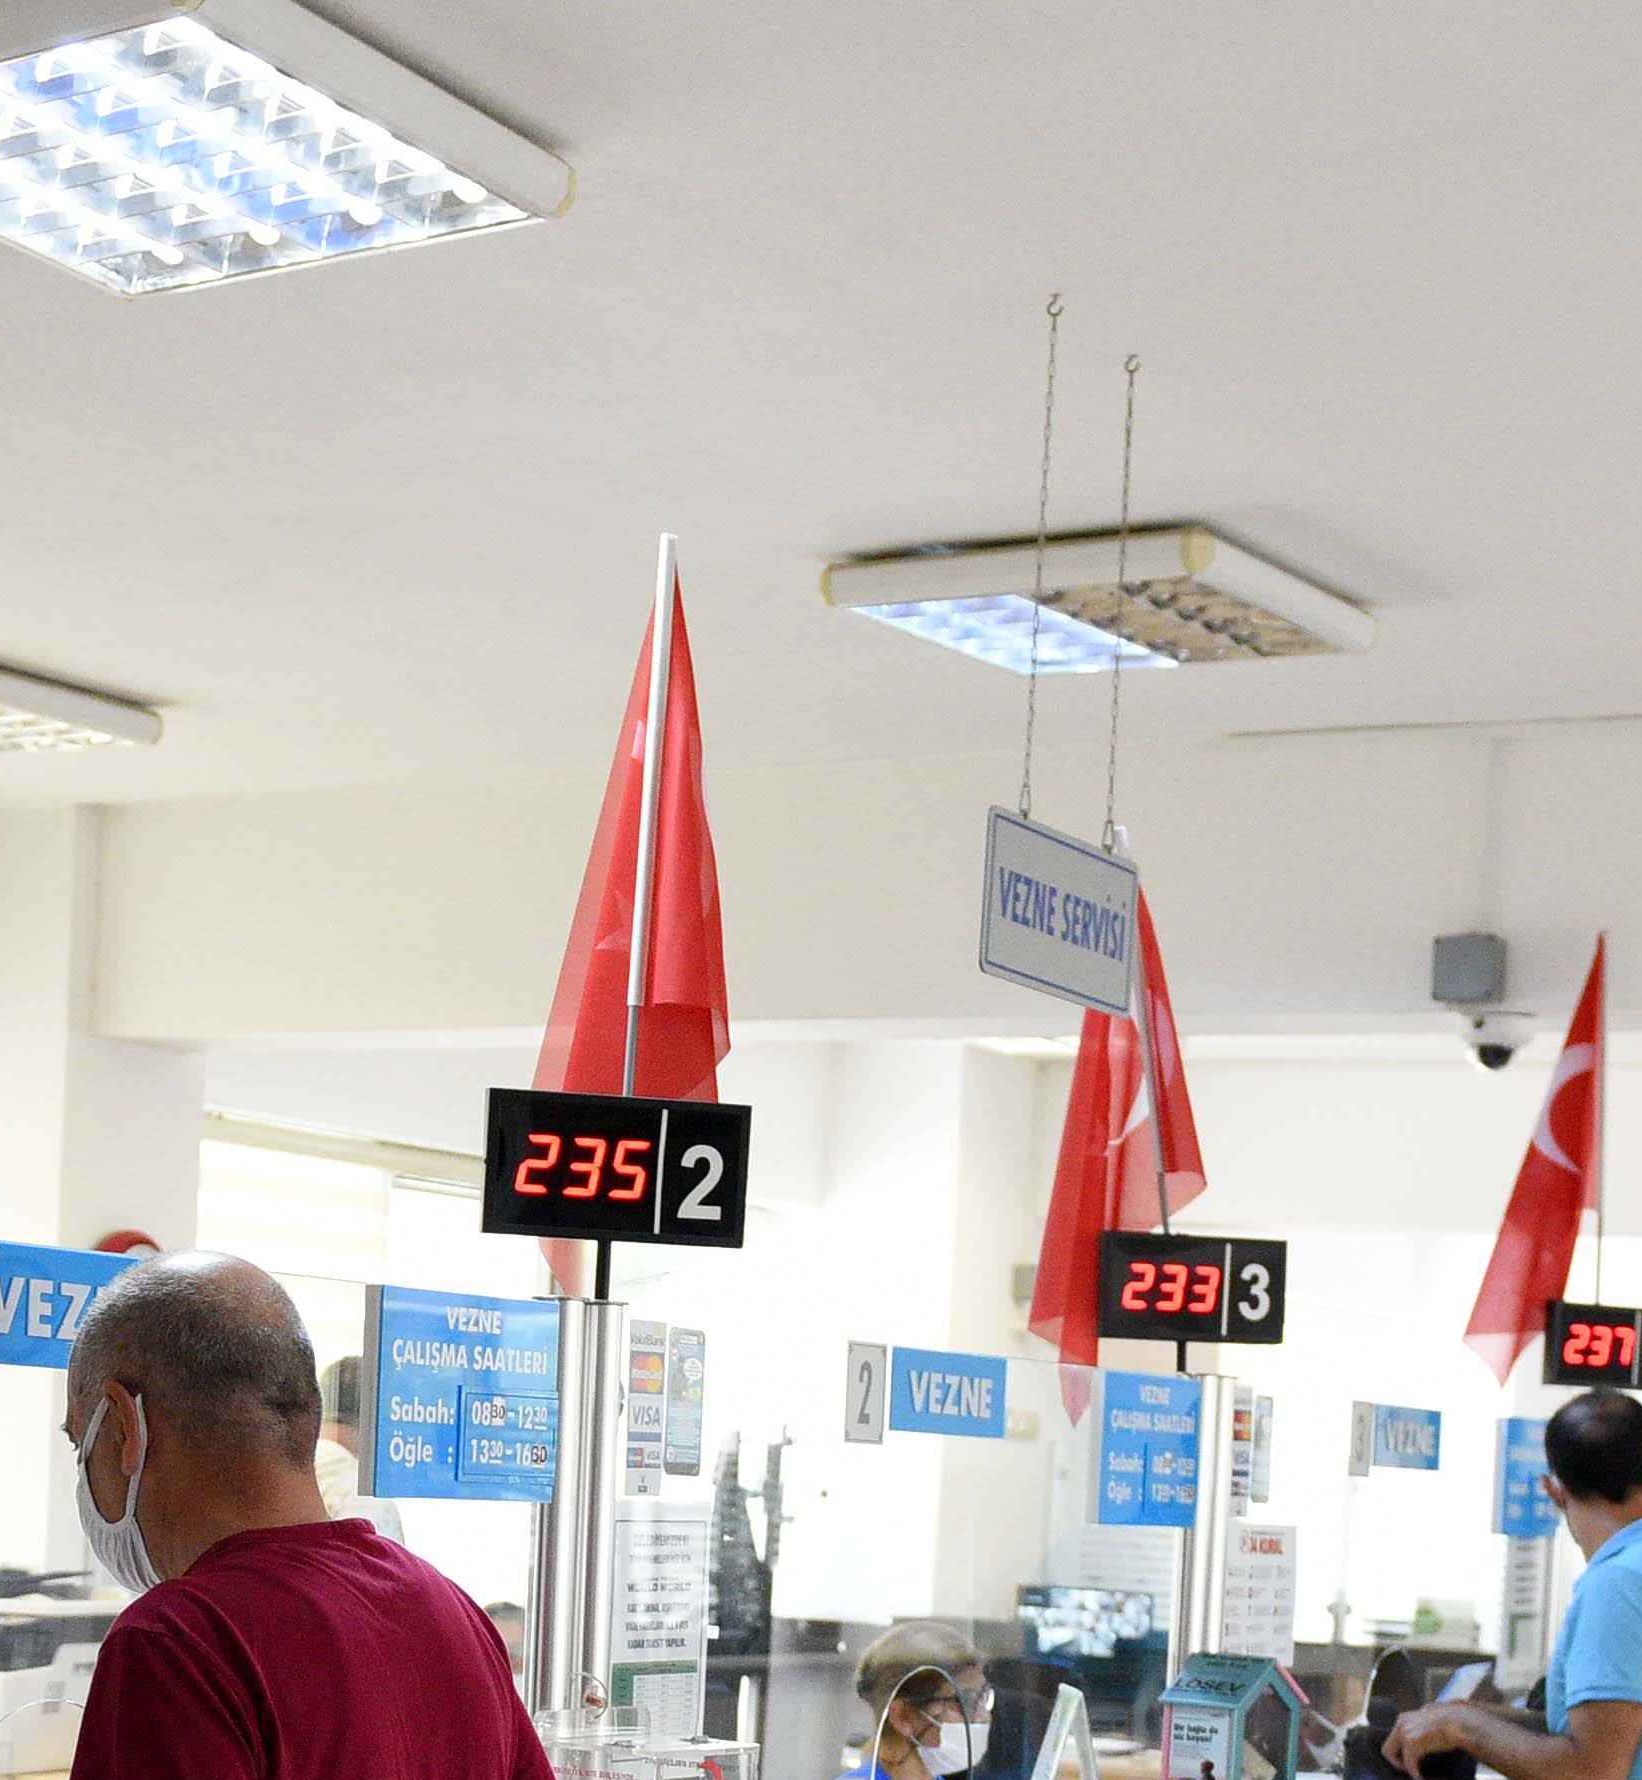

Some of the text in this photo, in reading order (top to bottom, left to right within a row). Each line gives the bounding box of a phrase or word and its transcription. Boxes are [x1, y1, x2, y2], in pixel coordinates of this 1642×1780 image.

[999, 866, 1127, 962] VEZNE SERVİSİ
[514, 1133, 725, 1221] 235 2
[1120, 1261, 1271, 1321] 233 3
[446, 1305, 503, 1335] VEZNE
[392, 1338, 548, 1376] ÇALIŞMA SAATLERİ
[1562, 1322, 1637, 1368] 237
[390, 1395, 455, 1425] Sabah:
[633, 1404, 661, 1426] VISA
[856, 1360, 873, 1425] 2
[910, 1369, 994, 1419] VEZNE
[389, 1430, 433, 1467] Öğle
